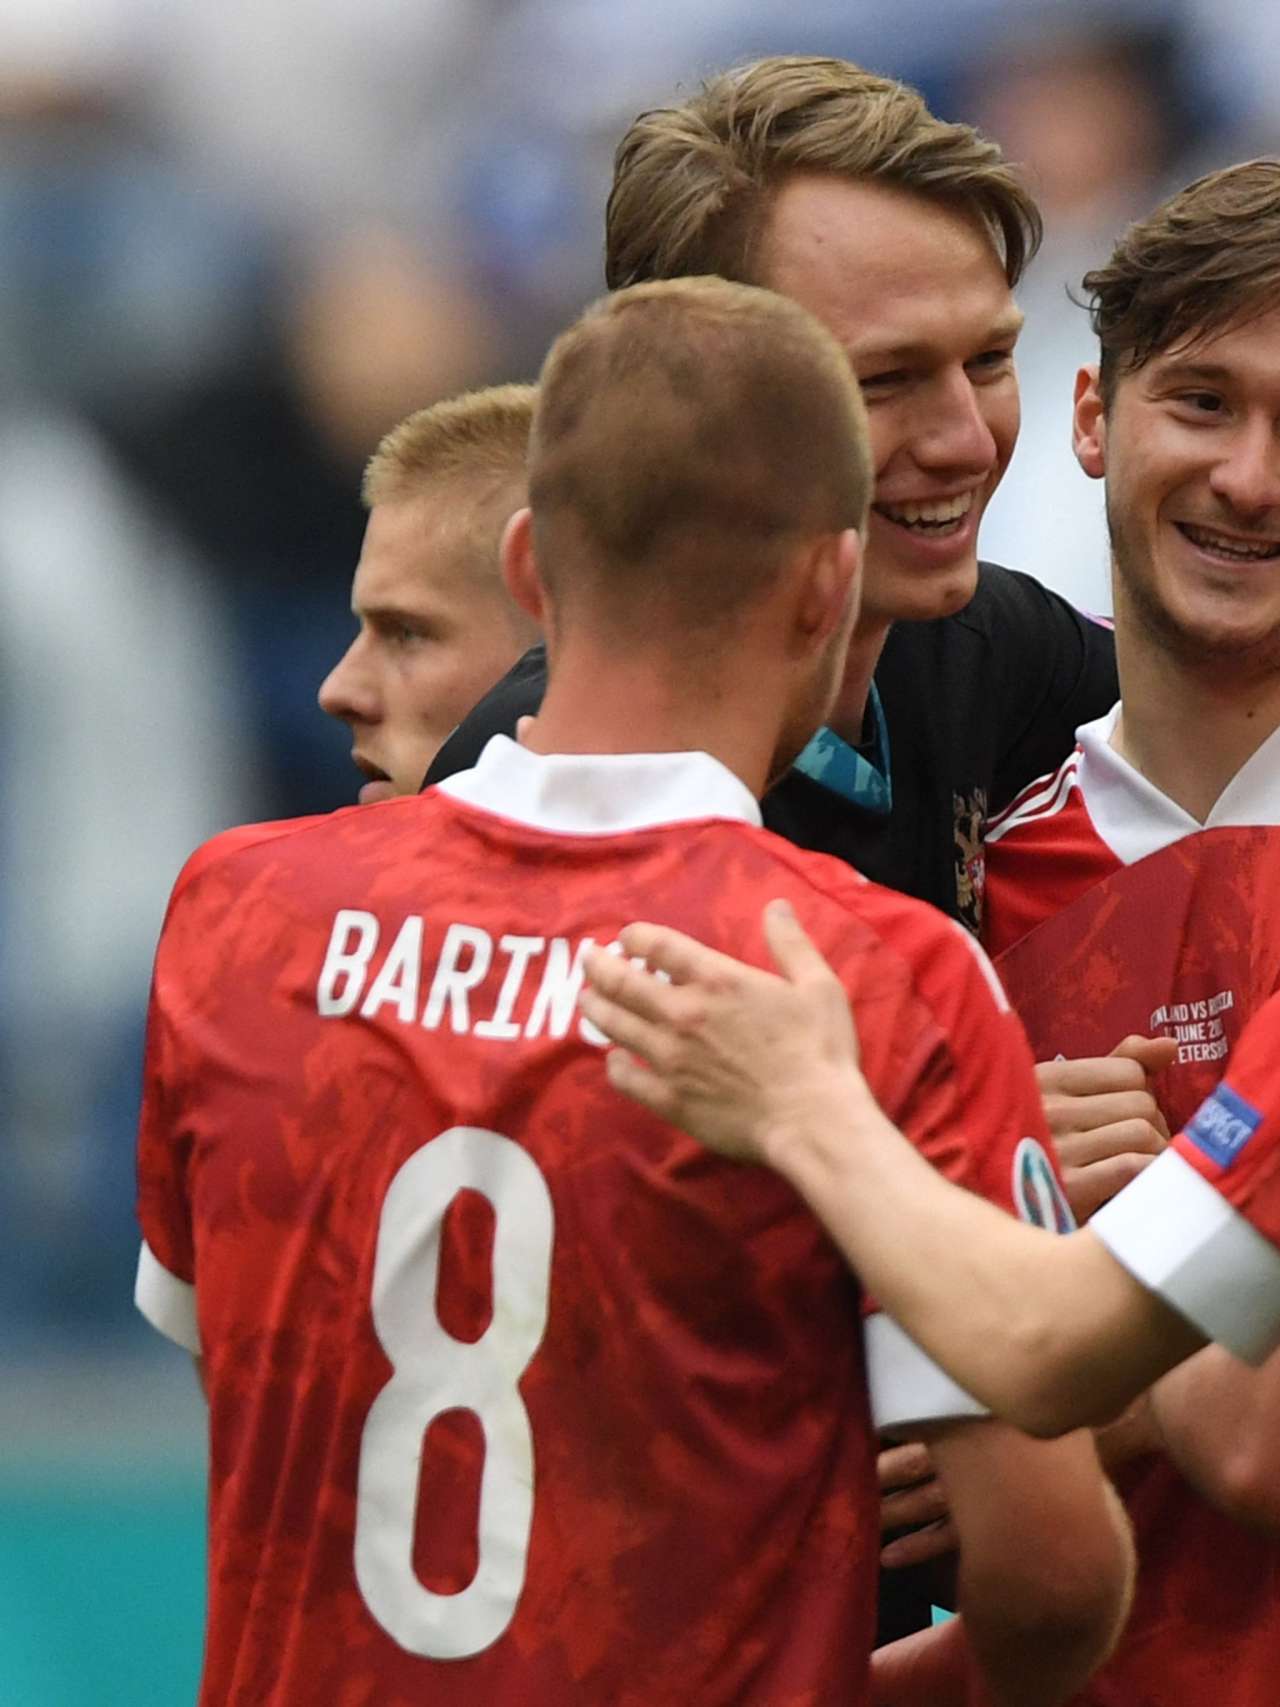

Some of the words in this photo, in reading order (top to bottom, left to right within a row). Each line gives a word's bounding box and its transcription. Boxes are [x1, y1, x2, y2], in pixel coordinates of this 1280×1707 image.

[316, 909, 671, 1048] BARIN
[1189, 1000, 1207, 1020] VS
[1174, 1022, 1207, 1043] JUNE
[353, 1125, 555, 1660] 8
